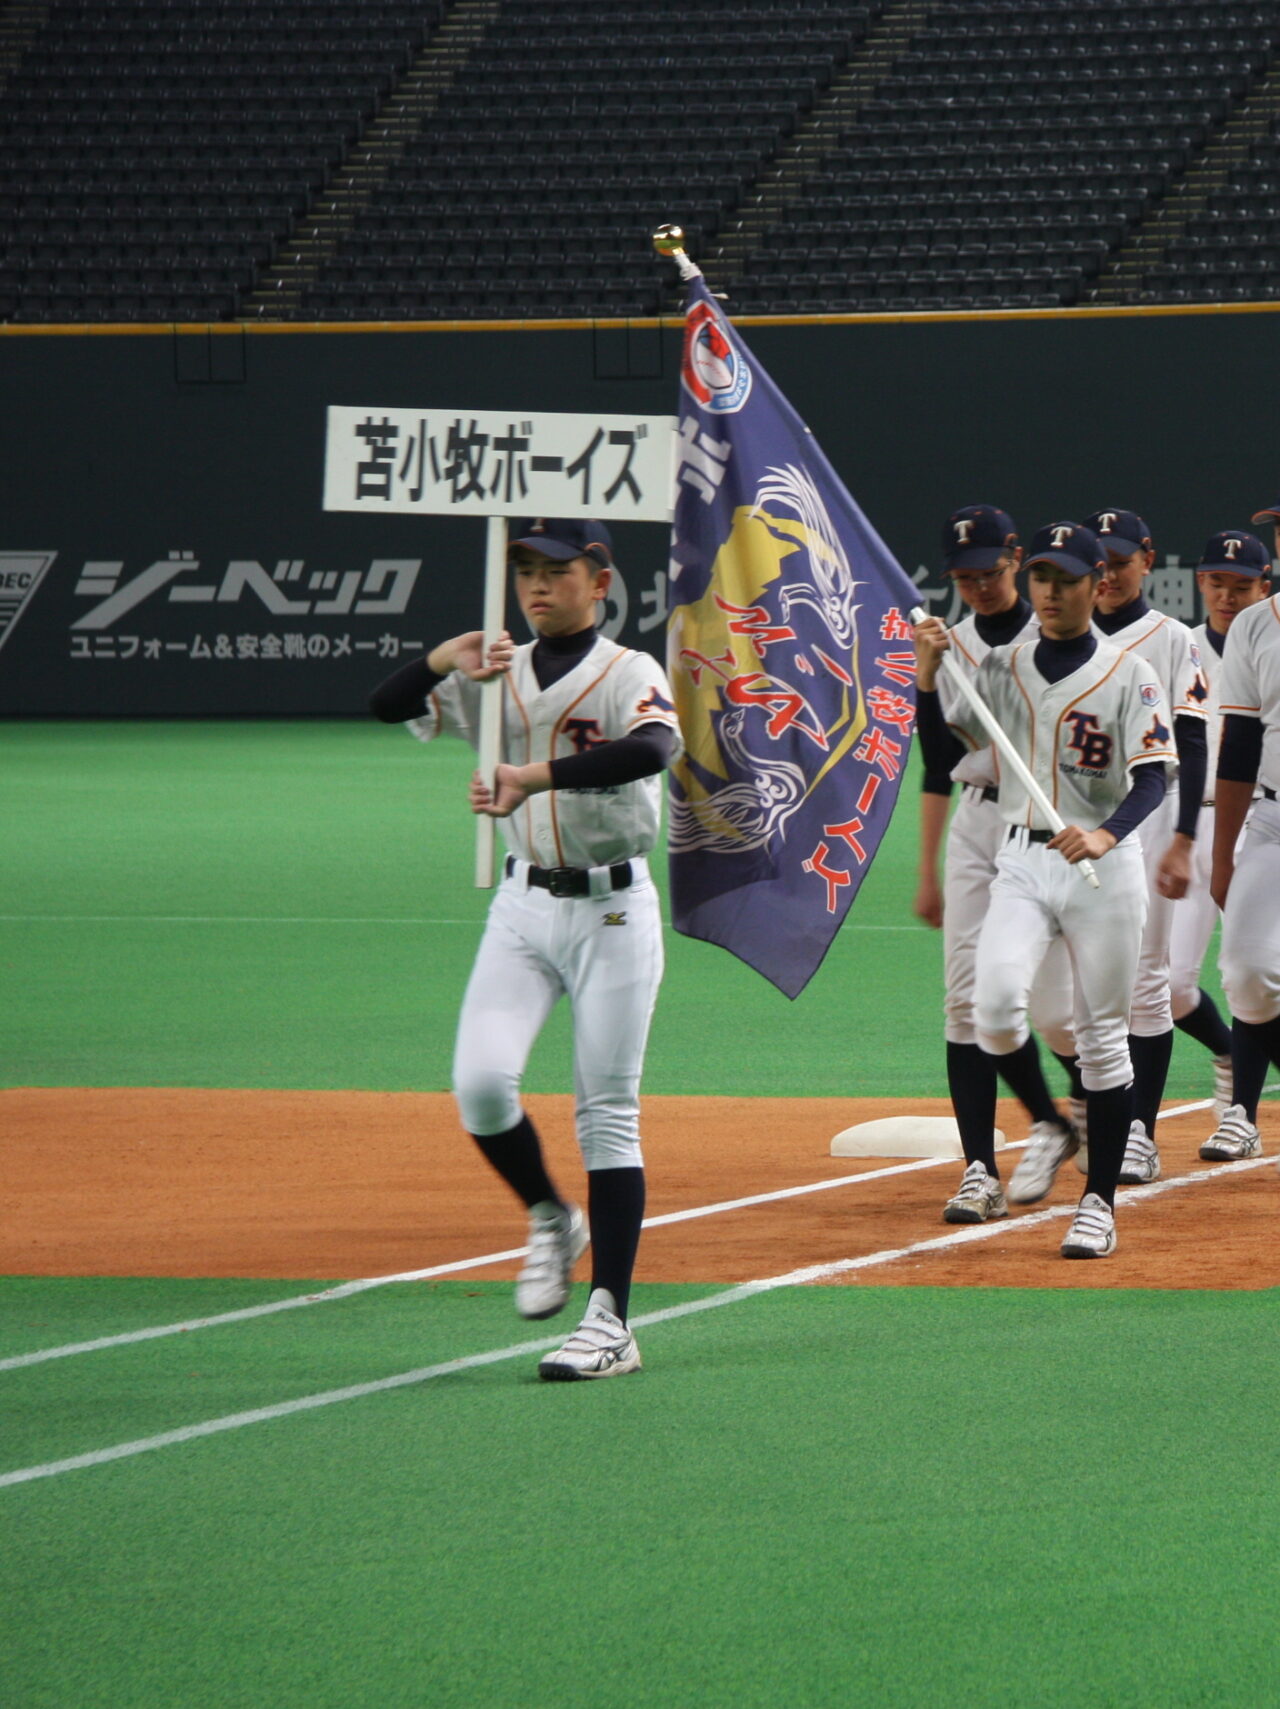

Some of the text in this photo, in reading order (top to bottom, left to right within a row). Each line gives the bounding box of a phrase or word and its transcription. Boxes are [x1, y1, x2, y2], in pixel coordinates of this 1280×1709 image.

[355, 416, 648, 505] 苫小牧ボーイズ
[954, 519, 974, 544] T
[1098, 512, 1118, 533] T
[1050, 526, 1072, 547] T
[1223, 538, 1242, 559] T
[69, 550, 423, 629] ジーベック
[1064, 710, 1113, 769] TB
